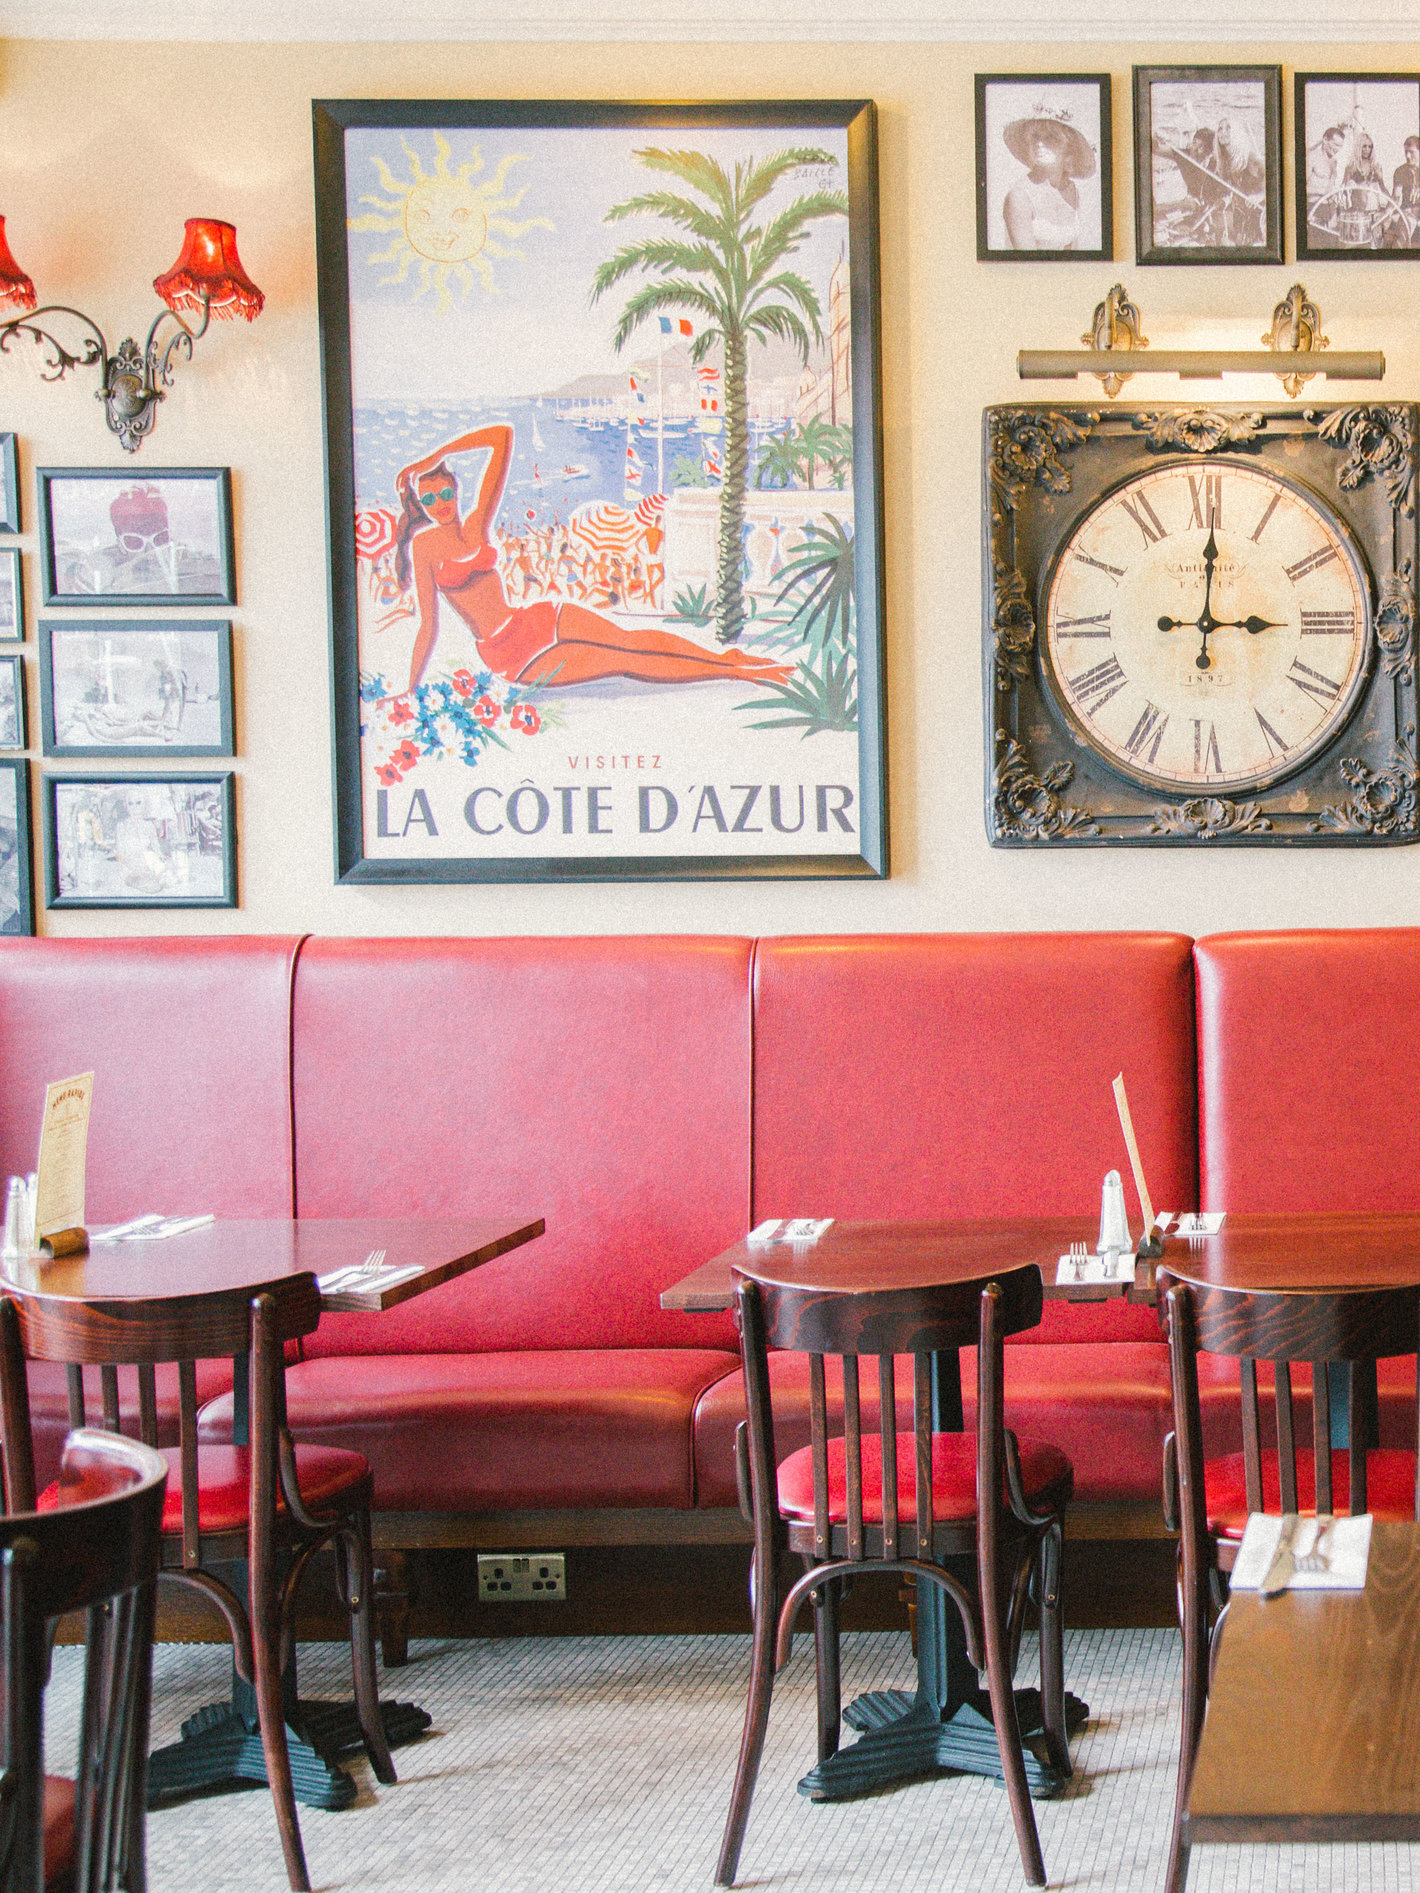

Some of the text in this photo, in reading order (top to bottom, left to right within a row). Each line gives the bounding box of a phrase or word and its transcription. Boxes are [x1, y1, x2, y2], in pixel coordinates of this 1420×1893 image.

[1117, 487, 1172, 551] XI
[1185, 474, 1224, 530] XII
[1300, 607, 1356, 640] III
[568, 755, 662, 769] VISITEZ
[376, 778, 856, 838] LA CÔTE D'AZUR
